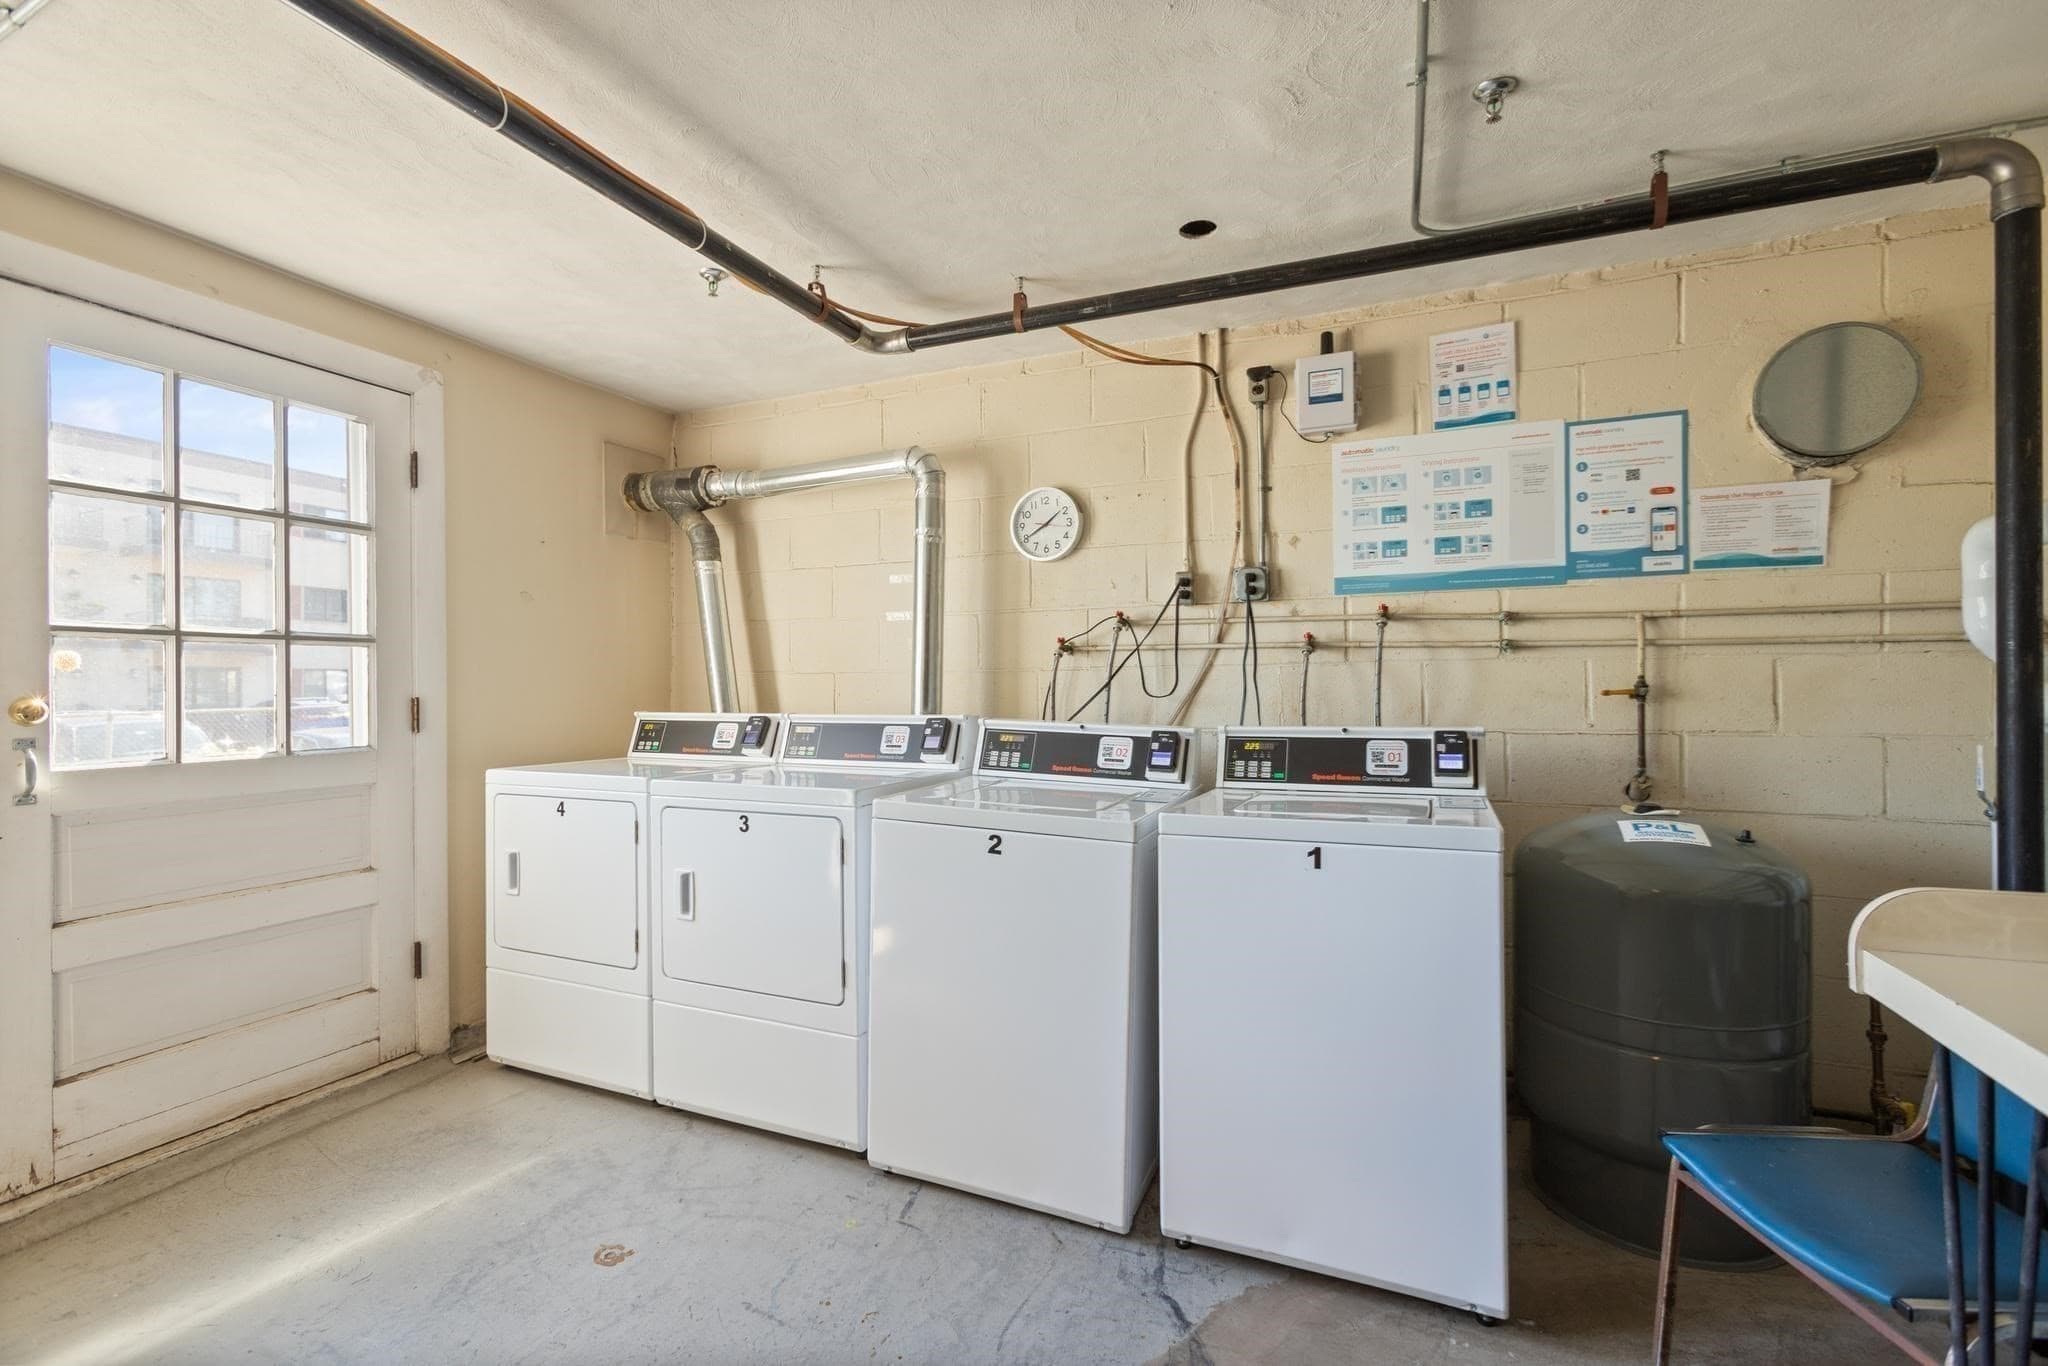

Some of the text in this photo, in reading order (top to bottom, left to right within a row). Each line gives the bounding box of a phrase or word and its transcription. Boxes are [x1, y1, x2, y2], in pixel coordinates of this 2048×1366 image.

[1030, 501, 1037, 510] 11
[1040, 496, 1050, 505] 12
[1021, 510, 1032, 519] 10
[1062, 506, 1069, 515] 2
[1019, 522, 1026, 531] 9
[1066, 517, 1073, 527] 3
[1023, 534, 1030, 544] 8
[1062, 531, 1069, 539] 4
[1033, 541, 1039, 552] 7
[1043, 544, 1050, 554] 6
[1054, 539, 1061, 549] 5
[895, 734, 905, 744] 03
[1115, 747, 1128, 758] 02
[1387, 751, 1403, 763] 01
[1311, 772, 1336, 782] Speed
[1337, 773, 1361, 782] Queen
[556, 801, 566, 817] 4
[738, 815, 750, 833] 3
[1631, 822, 1696, 834] P&L
[987, 834, 1003, 855] 2
[1306, 846, 1322, 870] 1
